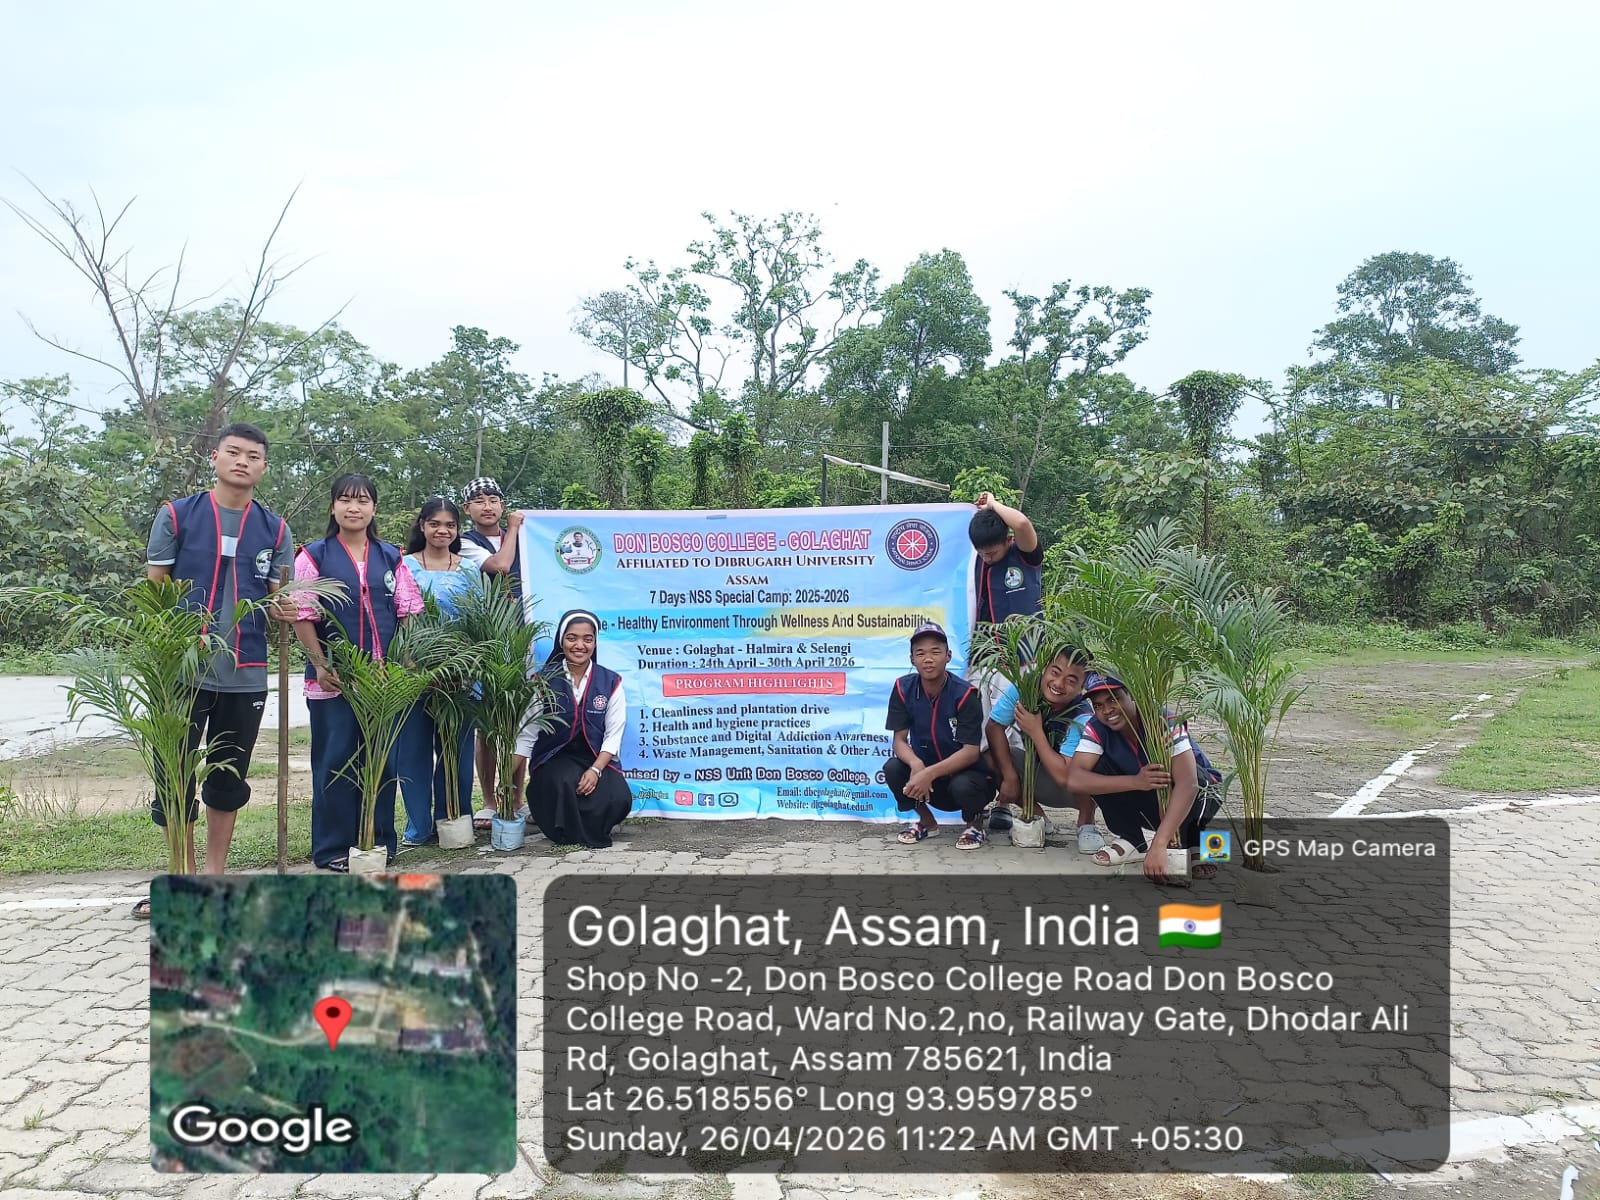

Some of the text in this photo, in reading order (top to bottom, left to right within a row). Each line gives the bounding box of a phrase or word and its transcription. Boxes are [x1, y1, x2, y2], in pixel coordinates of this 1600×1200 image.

[614, 533, 647, 553] DON
[649, 532, 703, 553] BOSCO
[706, 531, 777, 552] COLLEGE
[788, 529, 871, 551] GOLAGHAT
[650, 589, 850, 607] 7 Days NSS Special Camp: 2025-2026
[618, 615, 659, 633] Healthy
[662, 614, 729, 630] Environment
[732, 614, 778, 632] Through
[780, 614, 829, 629] Wellness
[832, 613, 854, 628] And
[637, 645, 672, 656] Venue
[683, 644, 734, 657] Golaghat
[746, 643, 793, 654] Halmira
[797, 642, 807, 654] &
[810, 642, 851, 656] Selengi
[638, 658, 689, 670] Duration
[699, 658, 724, 669] 24th
[727, 657, 757, 670] April
[768, 657, 792, 668] 30th
[795, 657, 825, 669] April
[829, 657, 856, 667] 2026
[675, 677, 833, 689] PROGRAM HIGHLIGHTS
[640, 704, 830, 719] 1. Cleanliness and plantation drive
[640, 717, 811, 733] 2. Health and hygiene practices
[639, 730, 889, 747] 3. Substance and Digital Addiction Awareness
[639, 749, 648, 759] 4.
[652, 748, 687, 759] Waste
[690, 745, 765, 758] Management,
[768, 744, 823, 755] Sanitation
[826, 744, 837, 755] &
[840, 744, 870, 756] Other
[622, 768, 659, 780] nised
[664, 769, 680, 783] by
[695, 769, 721, 782] NSS
[726, 766, 752, 781] Unit
[756, 767, 781, 780] Don
[785, 767, 824, 781] Bosco
[828, 768, 870, 785] College,
[777, 787, 801, 797] Email:
[777, 800, 809, 809] Website:
